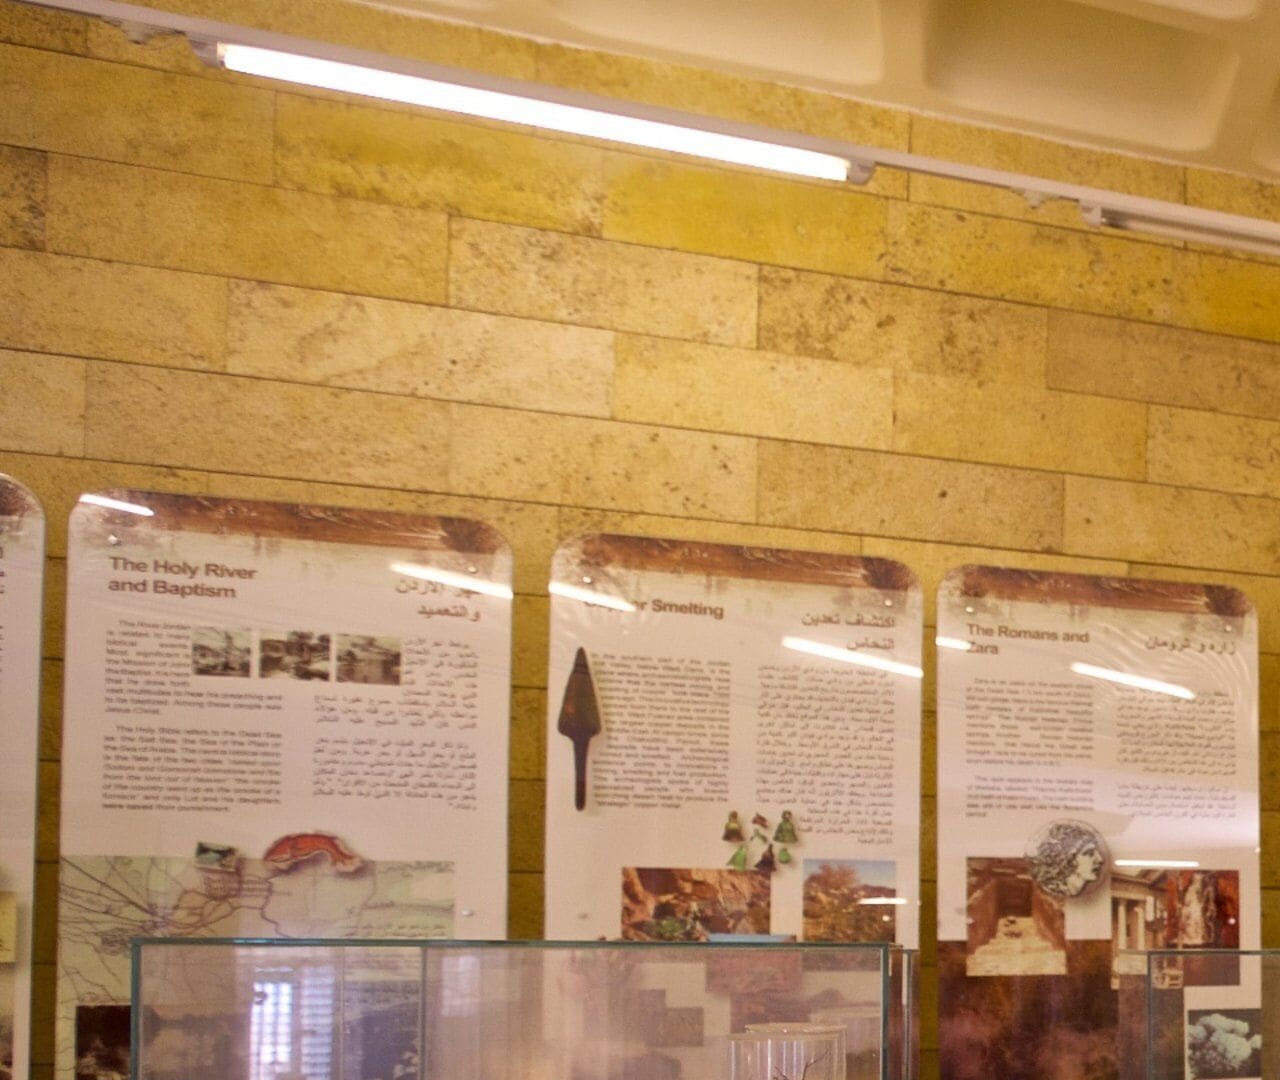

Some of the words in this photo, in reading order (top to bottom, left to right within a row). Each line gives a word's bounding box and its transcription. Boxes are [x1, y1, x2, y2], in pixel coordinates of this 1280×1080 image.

[109, 556, 148, 573] The
[154, 560, 199, 579] Holy
[205, 563, 258, 579] River
[109, 579, 147, 593] and
[153, 580, 237, 598] Baptism
[652, 599, 724, 620] Smelting
[967, 623, 994, 637] The
[998, 625, 1058, 640] Romans
[1062, 632, 1090, 642] and
[966, 641, 999, 655] Zara
